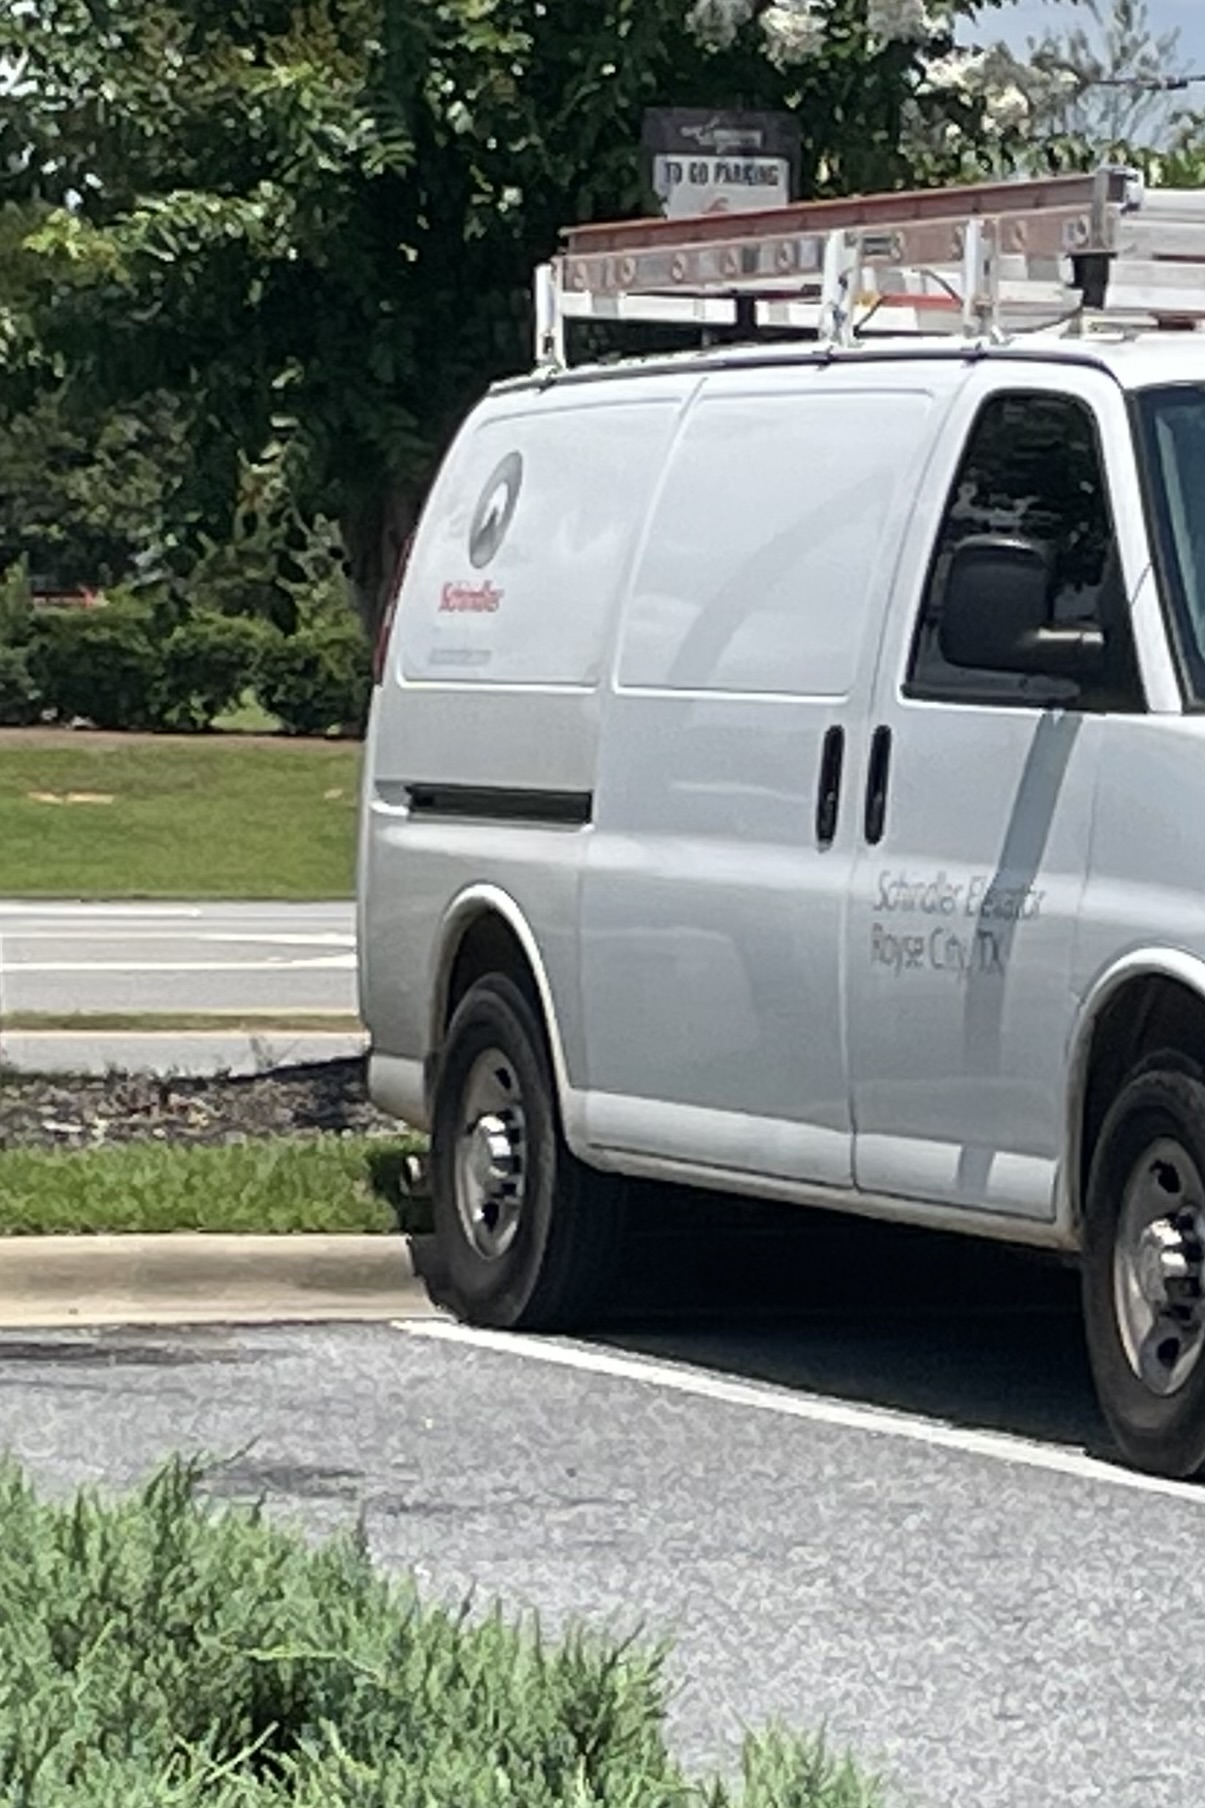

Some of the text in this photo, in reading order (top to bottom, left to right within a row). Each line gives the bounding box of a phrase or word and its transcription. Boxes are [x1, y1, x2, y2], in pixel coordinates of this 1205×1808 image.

[689, 162, 709, 184] GO
[714, 162, 779, 187] PARKING
[872, 870, 964, 915] Schindler
